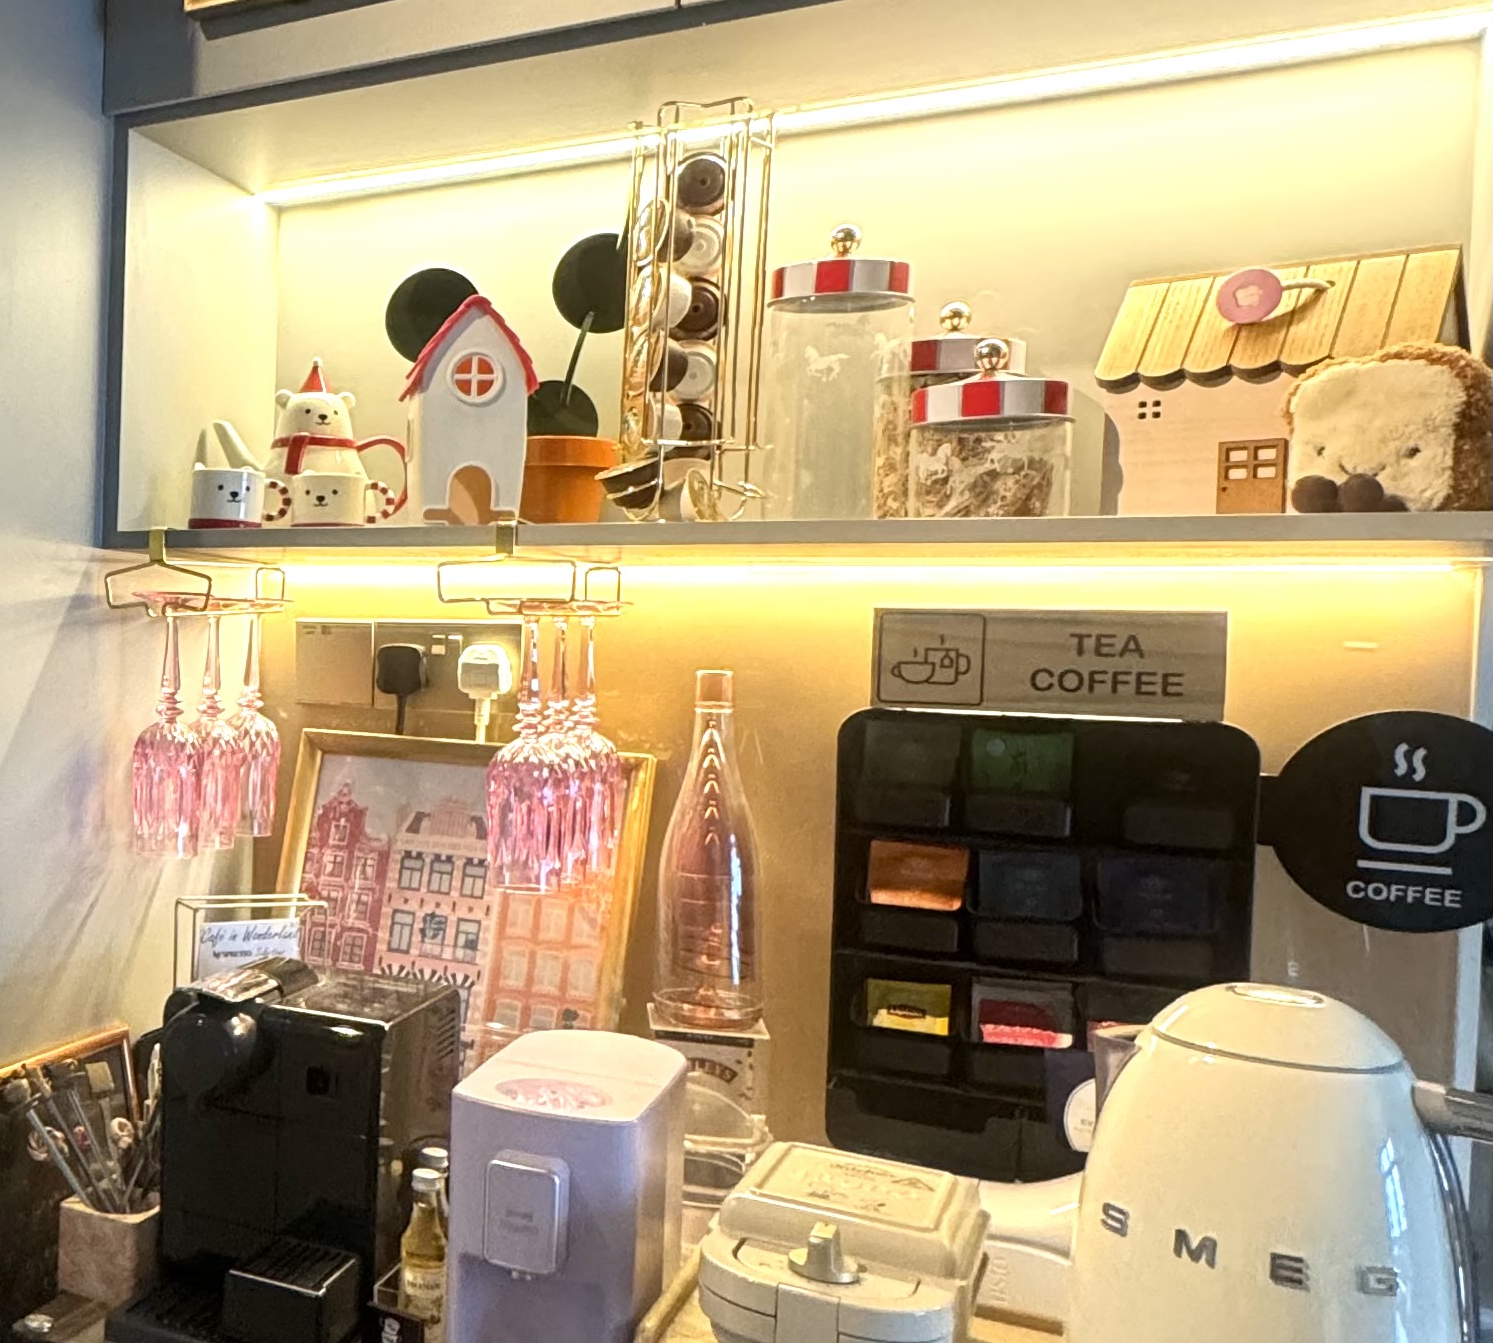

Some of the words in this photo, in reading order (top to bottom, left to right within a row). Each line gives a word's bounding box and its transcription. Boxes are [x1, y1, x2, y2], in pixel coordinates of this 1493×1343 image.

[1069, 633, 1146, 660] TEA
[1029, 668, 1186, 699] COFFEE
[1345, 879, 1463, 910] COFFEE
[1100, 1202, 1400, 1298] SMEG
